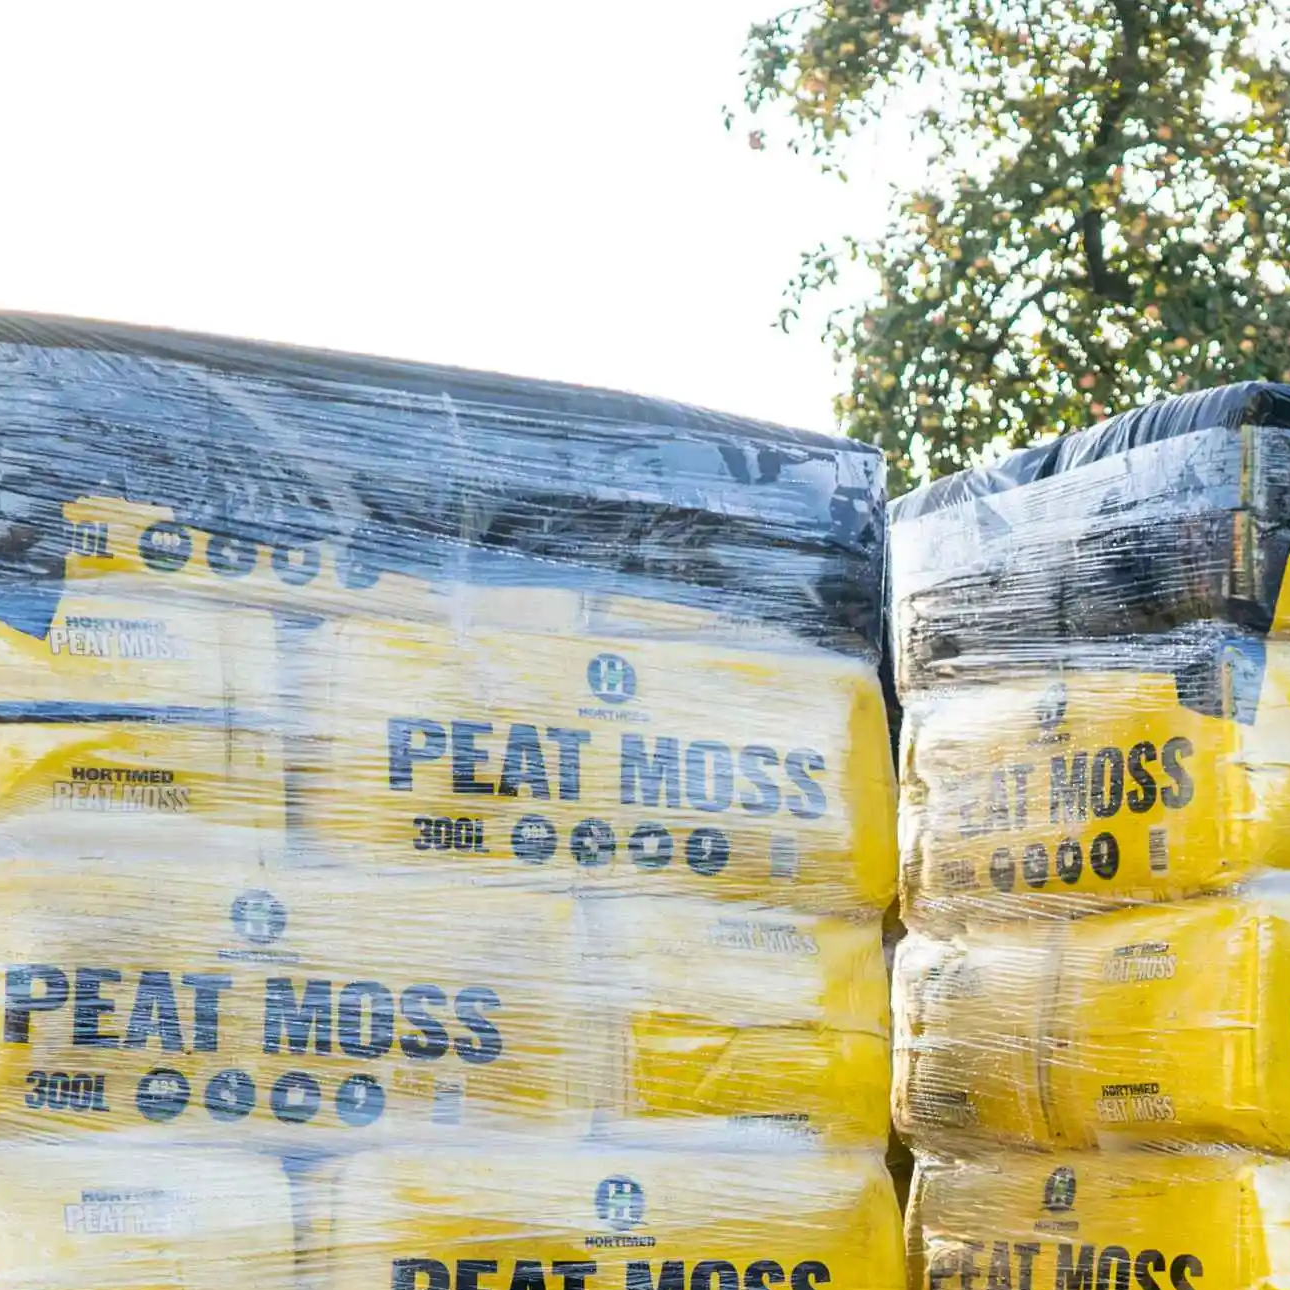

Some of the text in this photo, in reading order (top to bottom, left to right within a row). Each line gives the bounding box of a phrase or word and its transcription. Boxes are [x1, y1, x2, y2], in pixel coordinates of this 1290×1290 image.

[49, 627, 109, 656] PEAT
[71, 767, 174, 783] HORTIMED
[388, 718, 827, 820] PEAT MOSS
[1049, 736, 1195, 824] MOSS
[53, 781, 190, 812] PEAT MOSS
[413, 816, 489, 853] 300L
[4, 964, 503, 1064] PEAT MOSS
[25, 1071, 109, 1112] 300L
